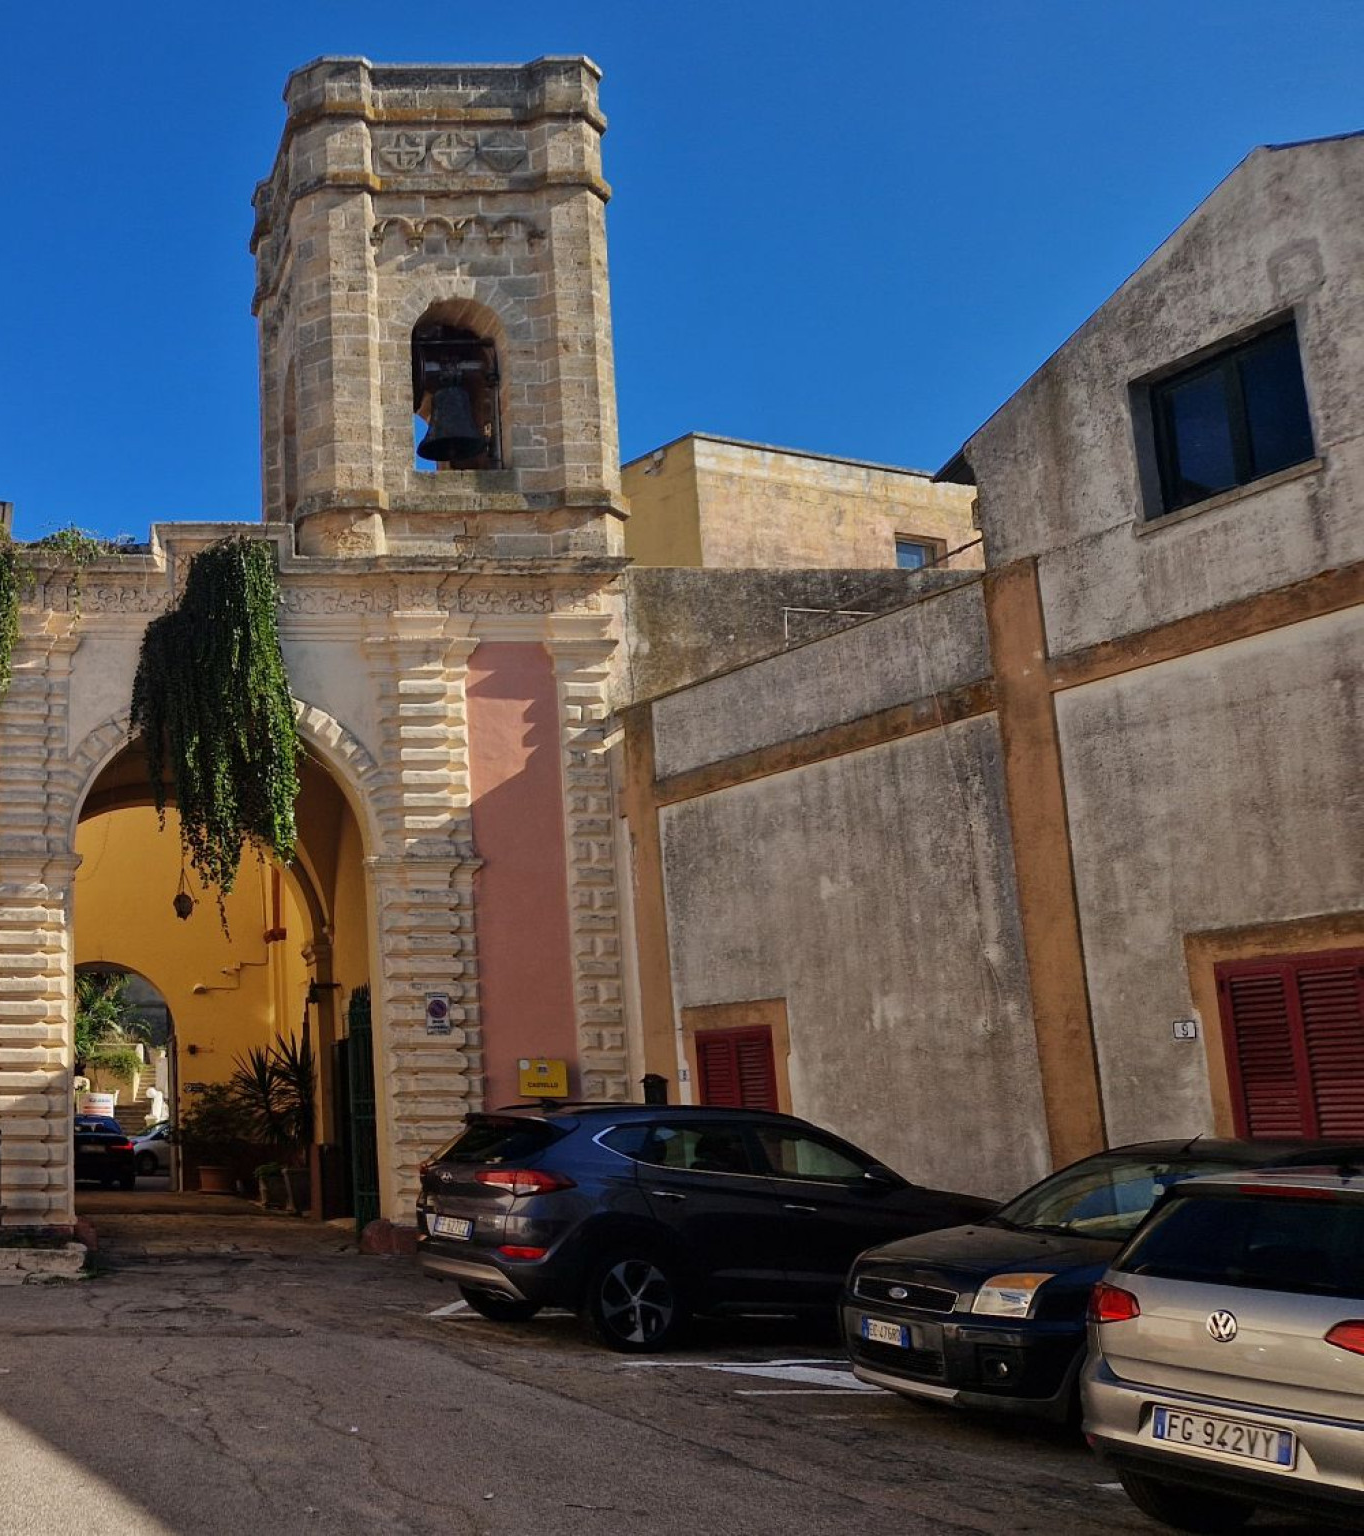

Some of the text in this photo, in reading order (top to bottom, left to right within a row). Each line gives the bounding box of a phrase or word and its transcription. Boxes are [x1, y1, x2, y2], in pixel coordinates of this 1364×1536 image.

[1181, 1023, 1189, 1037] 9
[1167, 1414, 1193, 1441] FG
[1203, 1421, 1275, 1458] 942VY
